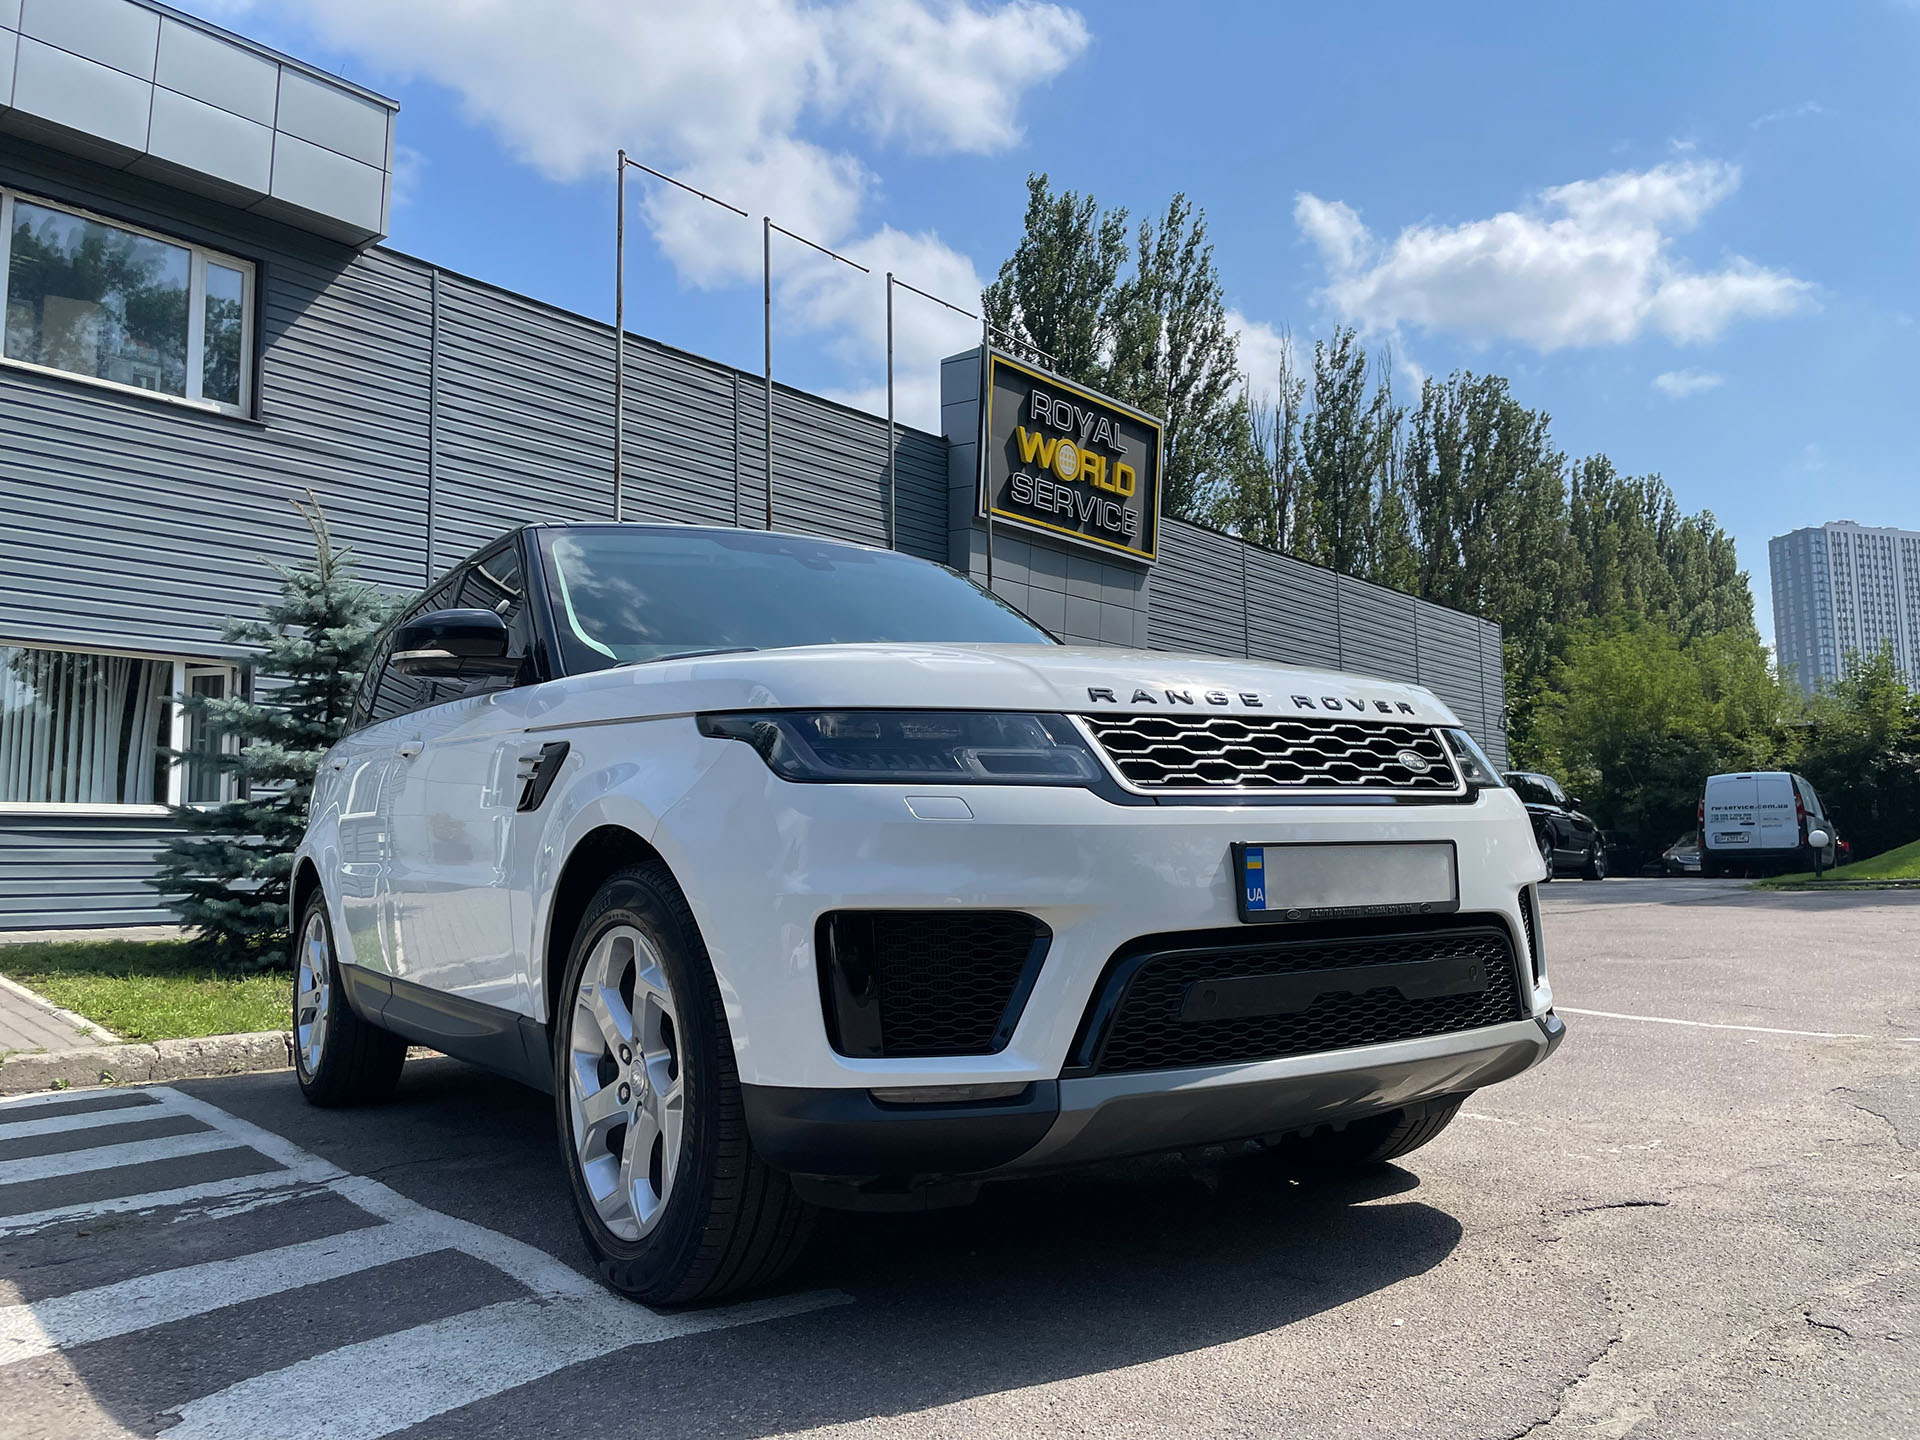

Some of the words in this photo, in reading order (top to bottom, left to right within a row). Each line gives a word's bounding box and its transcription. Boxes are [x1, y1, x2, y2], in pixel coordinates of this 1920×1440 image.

[1030, 389, 1129, 454] ROYAL
[1016, 426, 1136, 497] WORLD
[1011, 472, 1139, 537] SERVICE
[1087, 687, 1264, 708] RANGE
[1290, 694, 1416, 716] ROVER
[1246, 887, 1264, 902] UA
